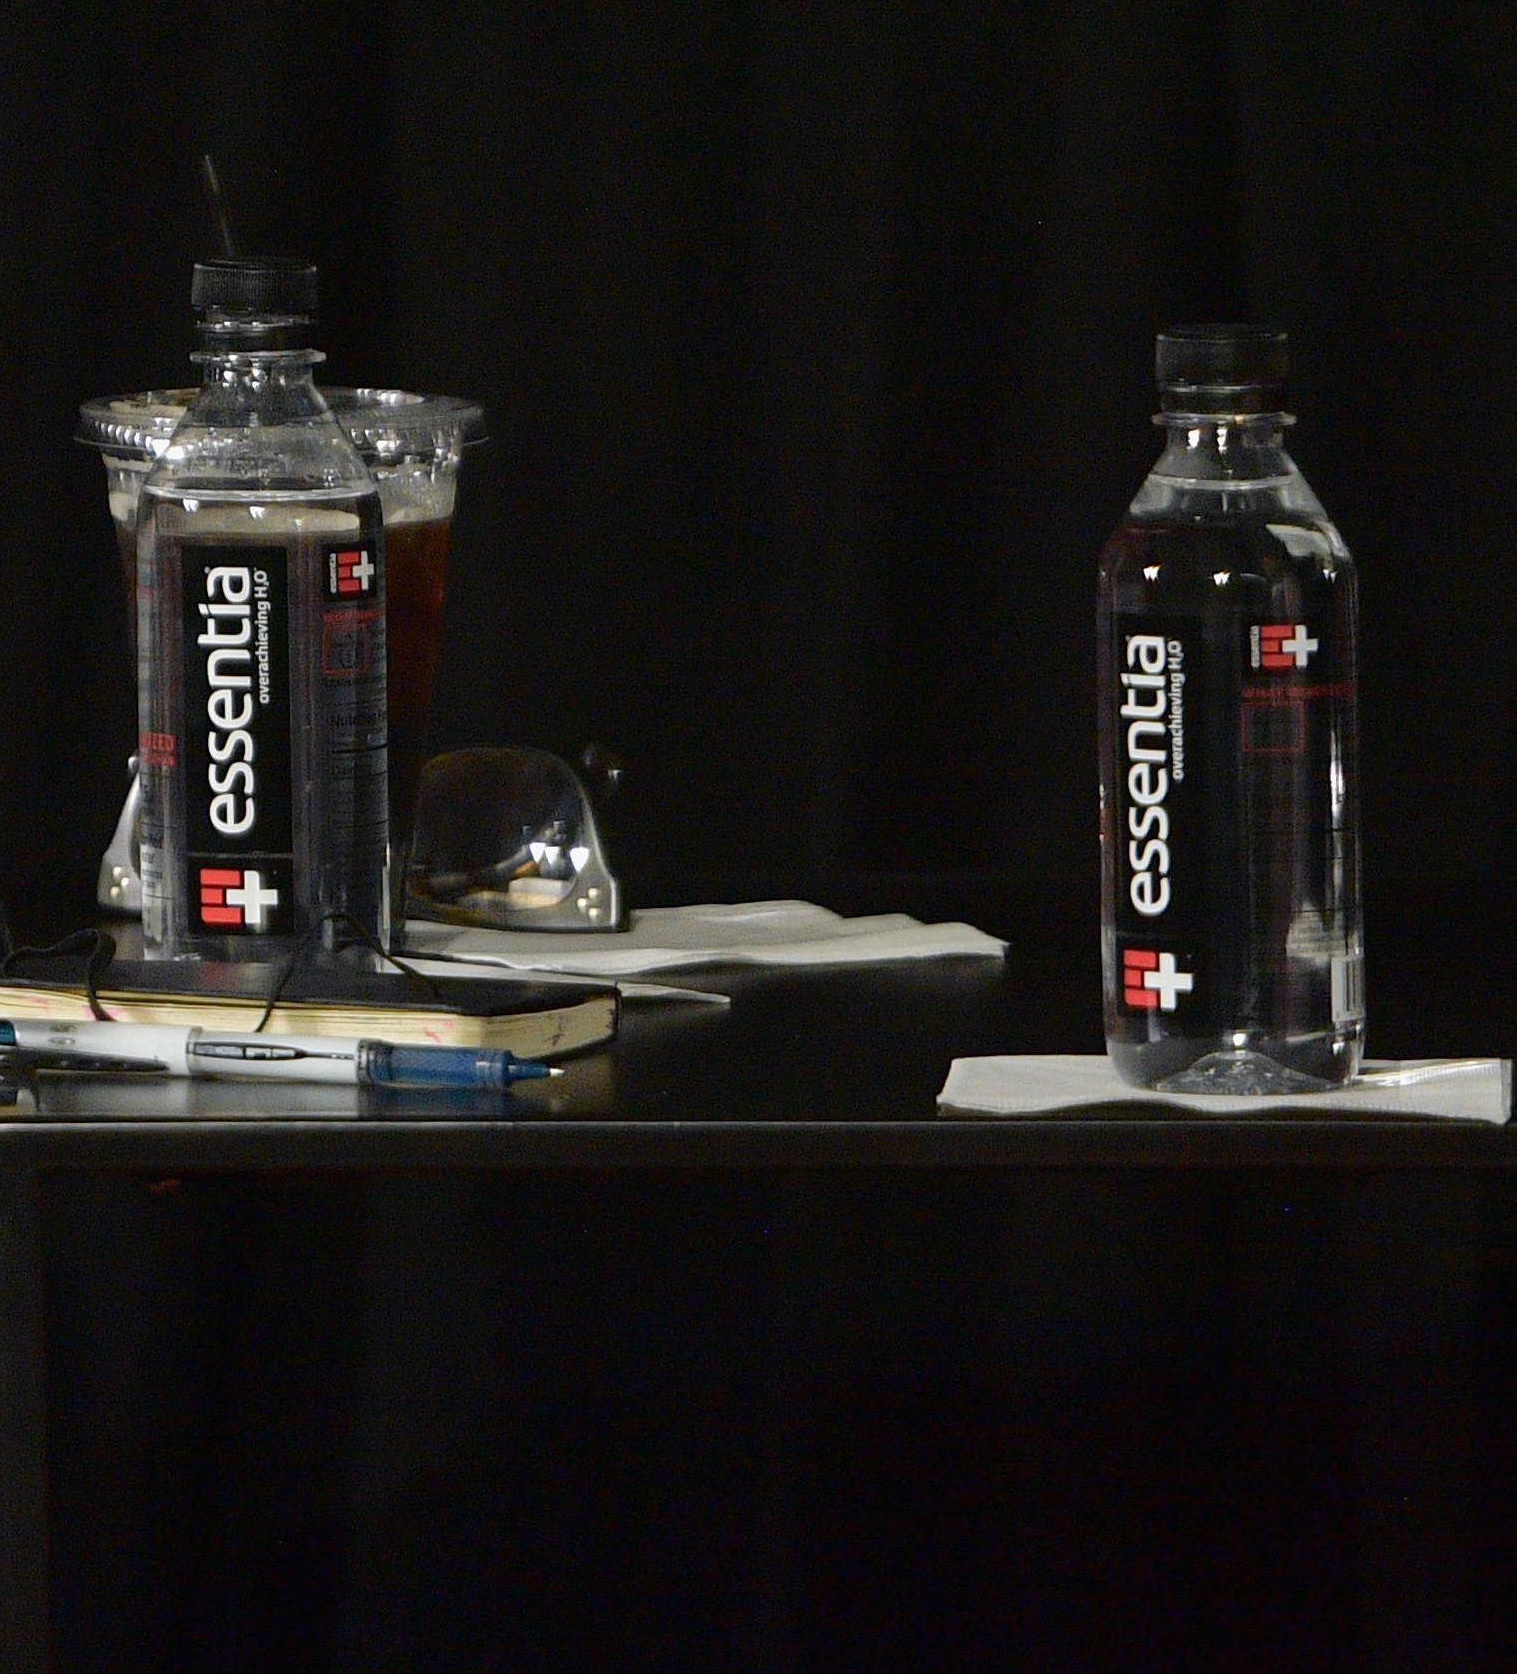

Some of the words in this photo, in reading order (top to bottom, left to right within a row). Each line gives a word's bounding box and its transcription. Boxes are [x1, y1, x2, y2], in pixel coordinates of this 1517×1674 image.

[196, 566, 255, 835] essentia
[254, 601, 271, 705] overachieving
[1168, 673, 1186, 783] overachieving
[1120, 635, 1170, 917] essentia
